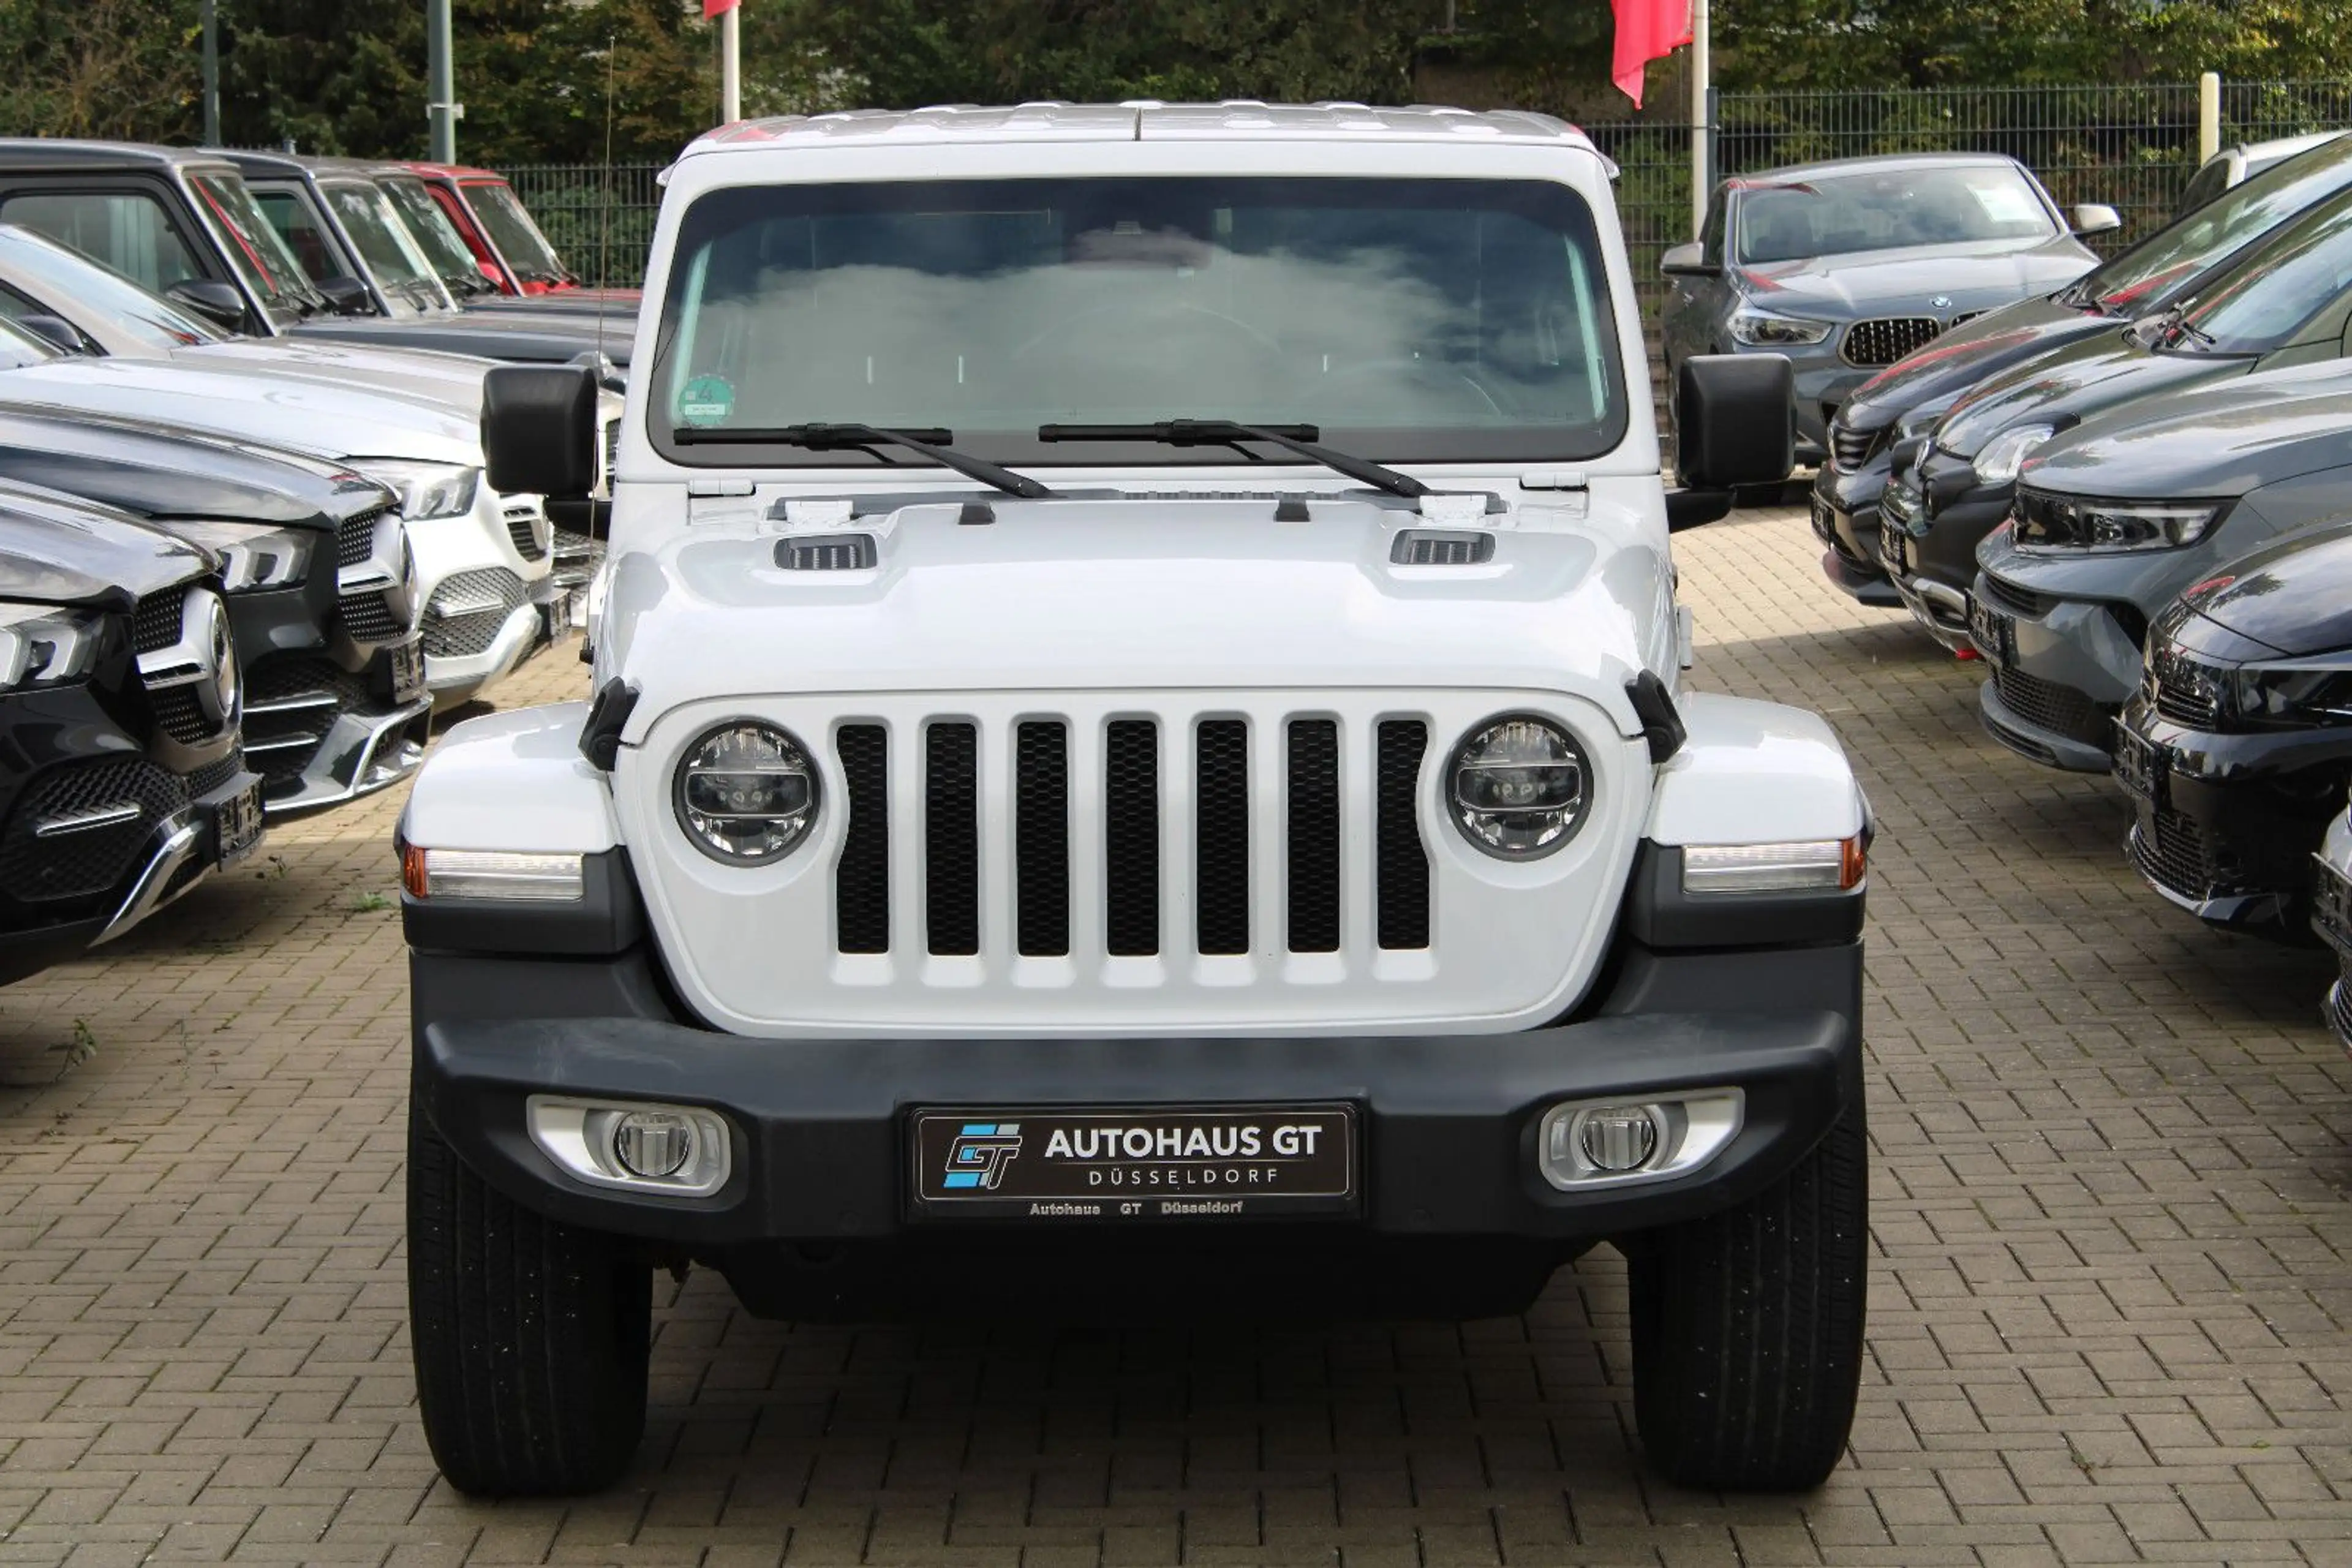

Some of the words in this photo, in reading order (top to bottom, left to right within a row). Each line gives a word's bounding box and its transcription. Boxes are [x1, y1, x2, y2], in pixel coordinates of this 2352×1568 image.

[1044, 1127, 1261, 1158] AUTOHAUS
[1272, 1125, 1322, 1155] GT
[1089, 1168, 1278, 1186] DÜSSELDORF
[1030, 1203, 1101, 1215] Autohaus
[1120, 1202, 1142, 1215] GT
[1161, 1200, 1244, 1214] Düsseldorf
